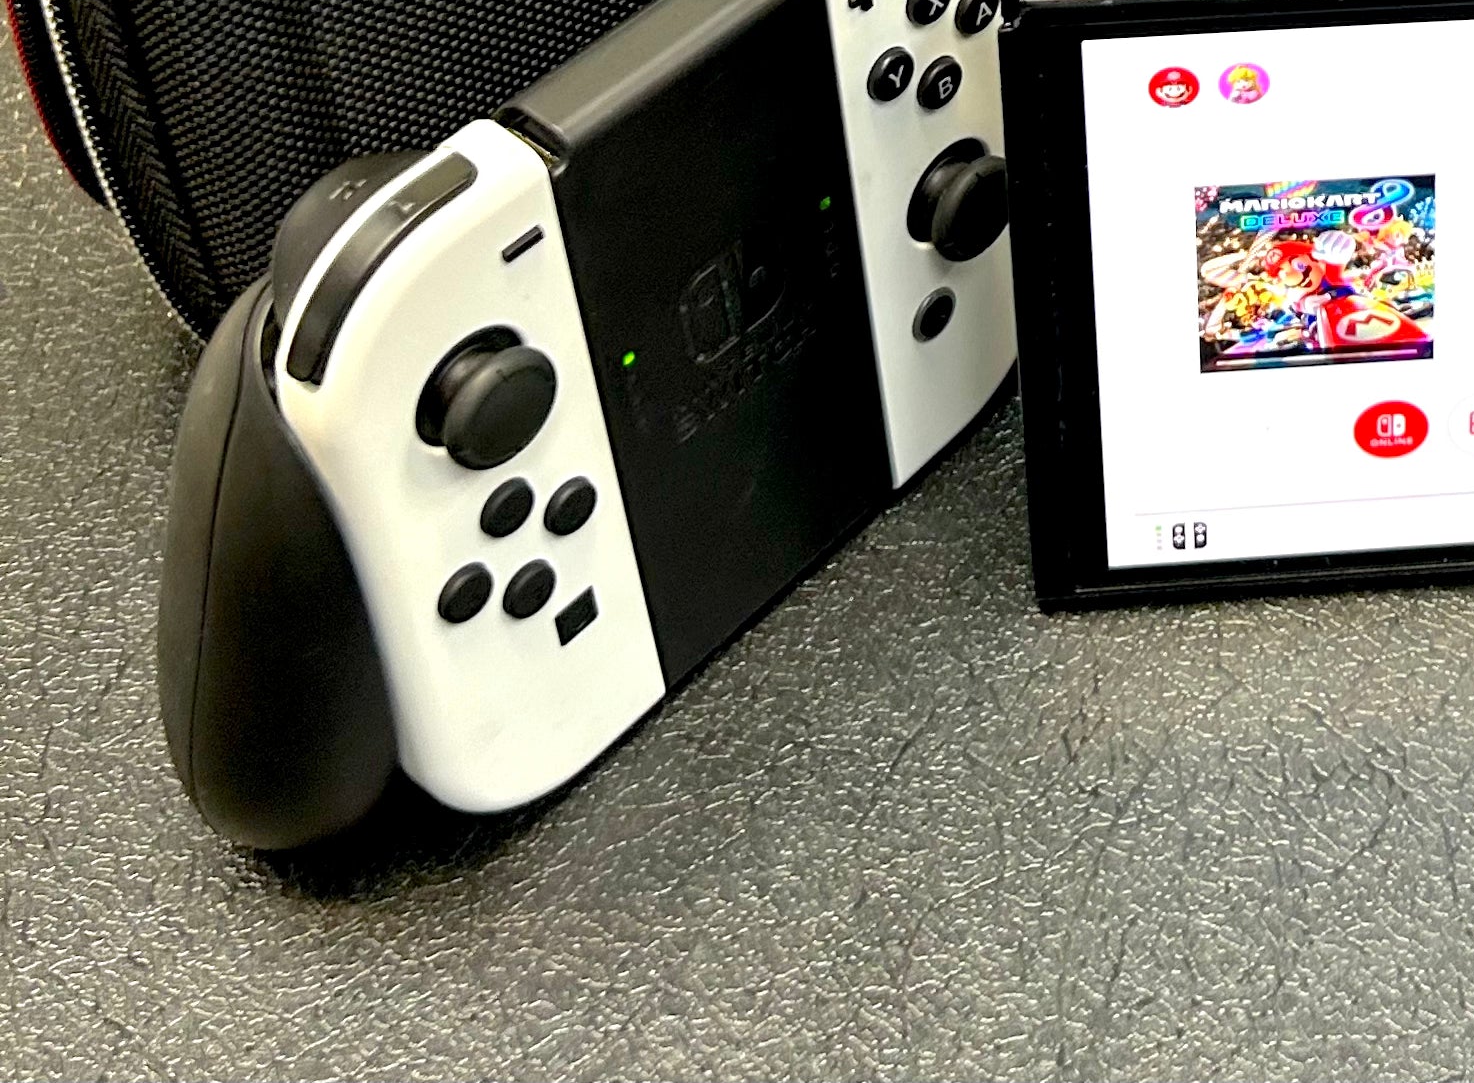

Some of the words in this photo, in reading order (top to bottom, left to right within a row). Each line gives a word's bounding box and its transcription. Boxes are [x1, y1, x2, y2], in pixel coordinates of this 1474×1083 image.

[975, 1, 993, 26] A
[888, 65, 905, 88] Y
[938, 76, 953, 99] B
[1240, 209, 1345, 232] DELUXE
